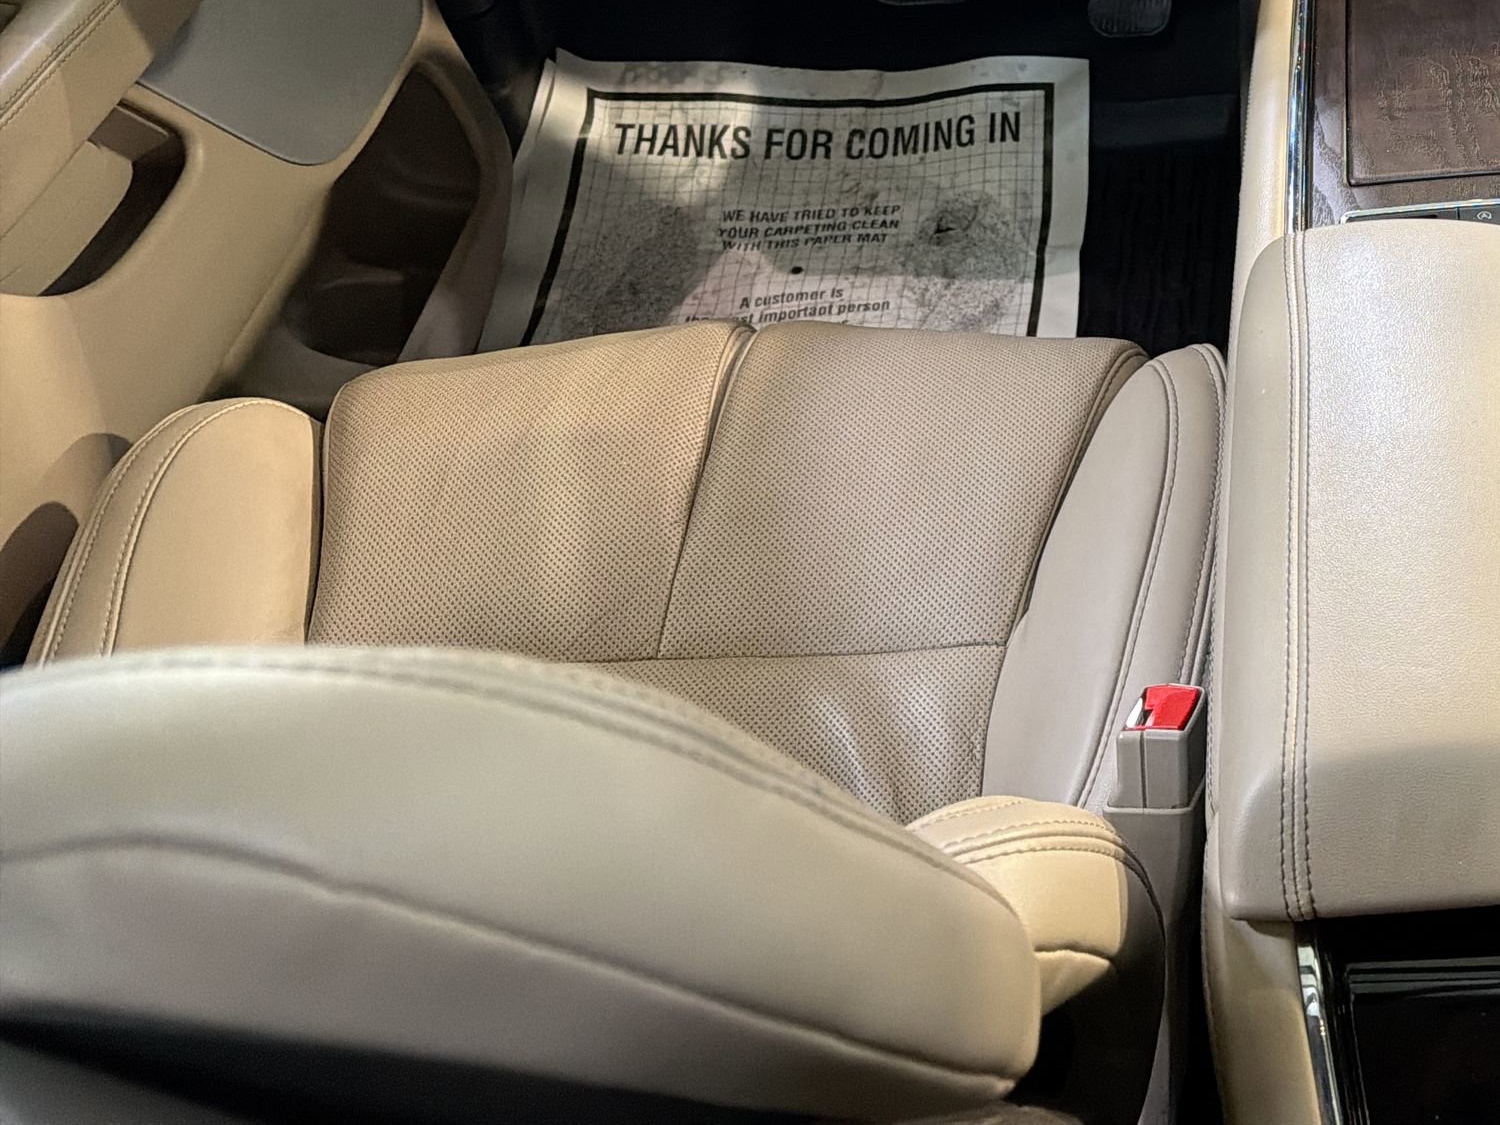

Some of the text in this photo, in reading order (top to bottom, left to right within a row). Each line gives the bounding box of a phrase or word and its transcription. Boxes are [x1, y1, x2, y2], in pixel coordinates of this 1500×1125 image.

[615, 112, 1020, 160] THANKS FOR COMING IN
[723, 205, 901, 222] WE HAVE TRIED TO KEEP
[718, 219, 899, 238] YOUR CARPETING CLEAN
[723, 233, 888, 251] WITH THIS PAPER MAT
[739, 297, 749, 309] A
[754, 290, 825, 307] customer
[758, 303, 833, 324] important
[837, 300, 890, 317] person
